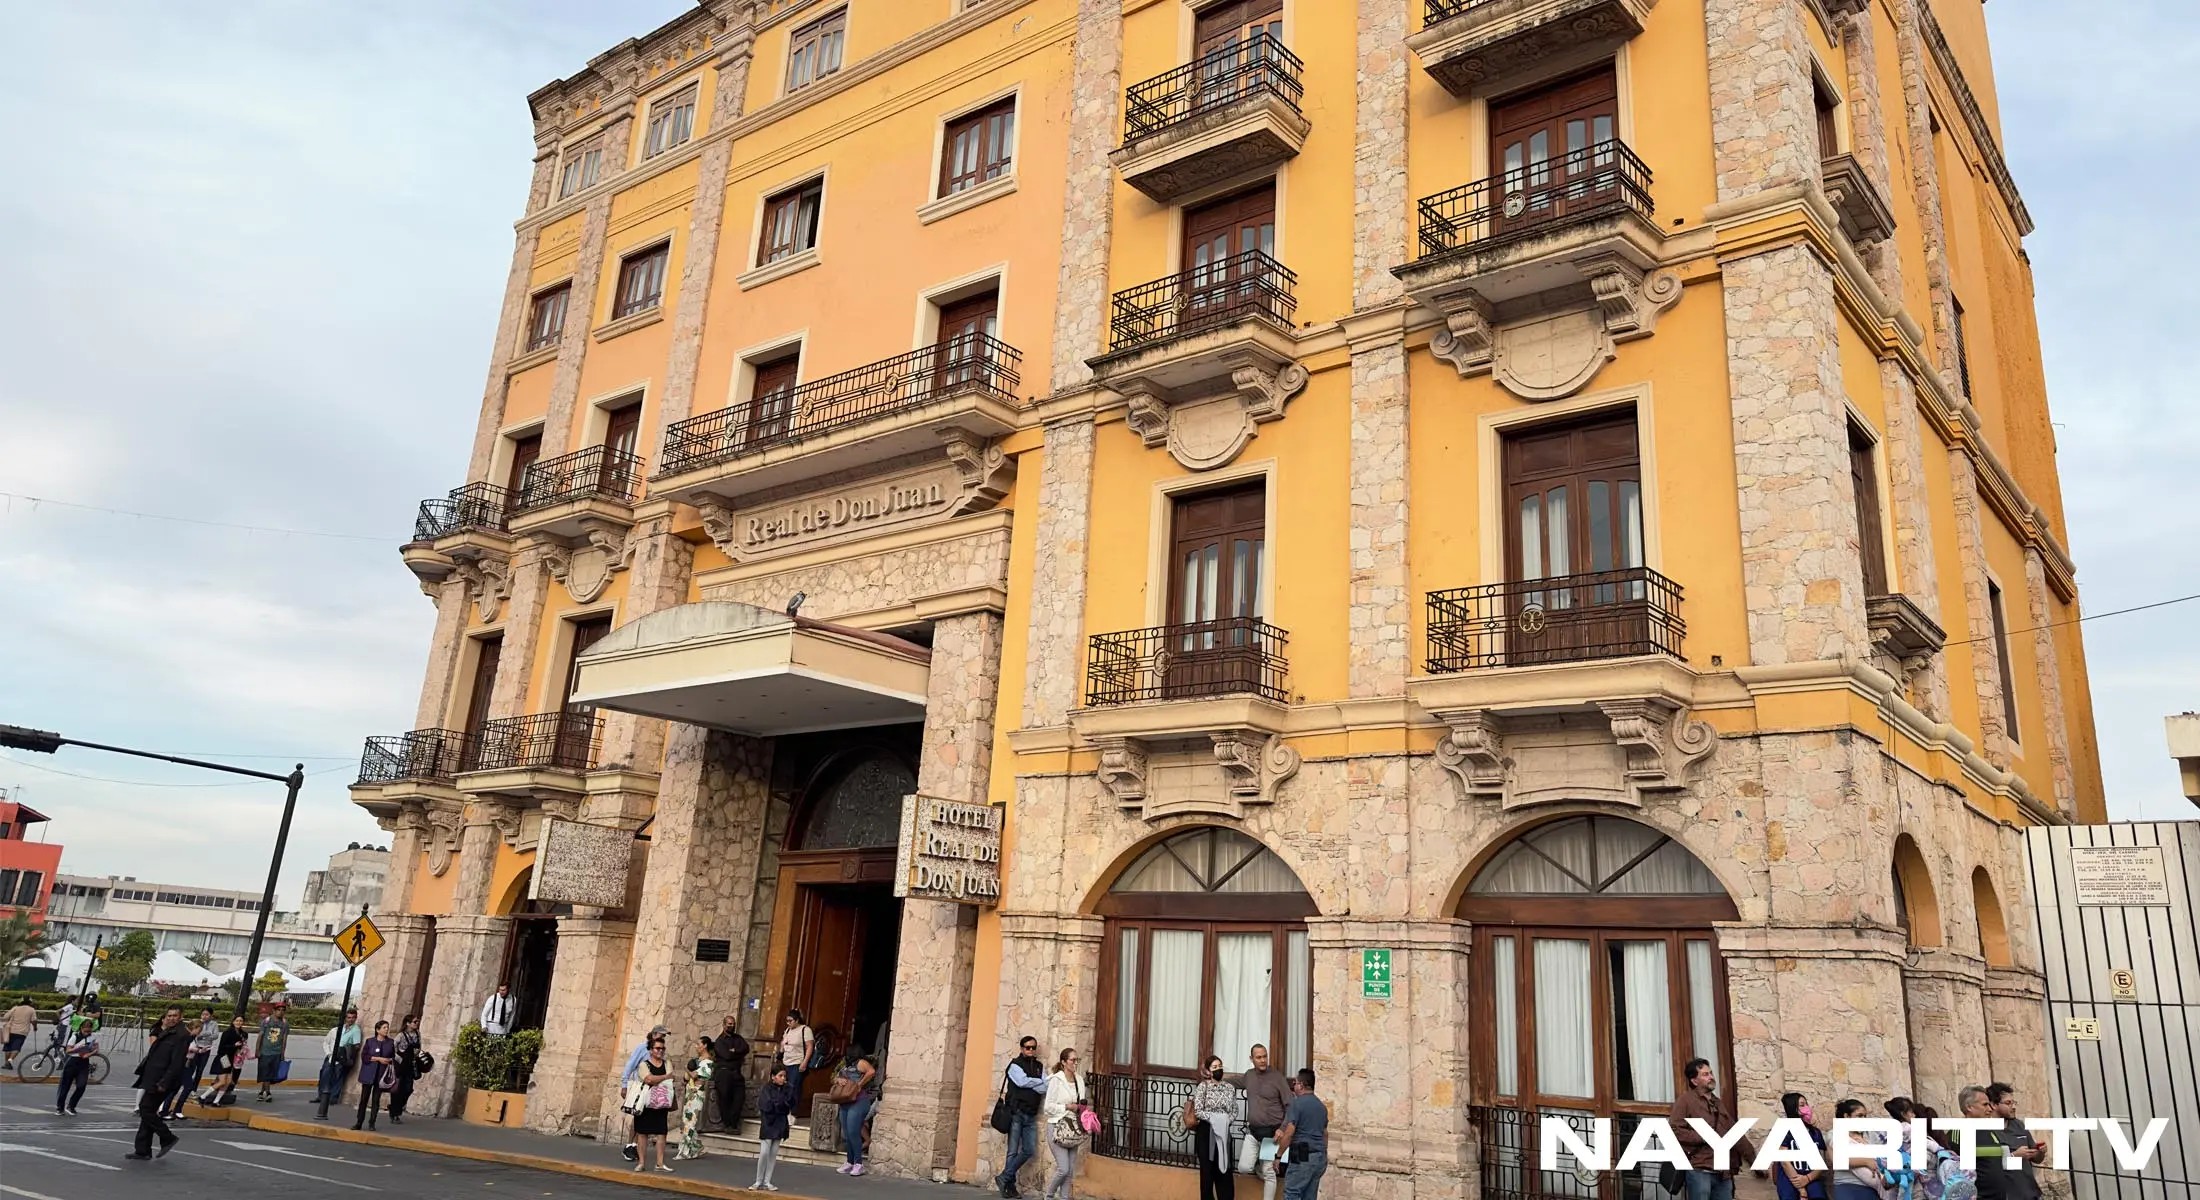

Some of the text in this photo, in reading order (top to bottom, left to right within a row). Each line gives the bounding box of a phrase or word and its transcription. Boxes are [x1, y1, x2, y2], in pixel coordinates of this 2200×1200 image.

[746, 483, 944, 544] Real de Don Juan
[933, 805, 992, 829] HOTEL
[977, 845, 999, 863] DE
[912, 865, 1001, 898] DON JUAN
